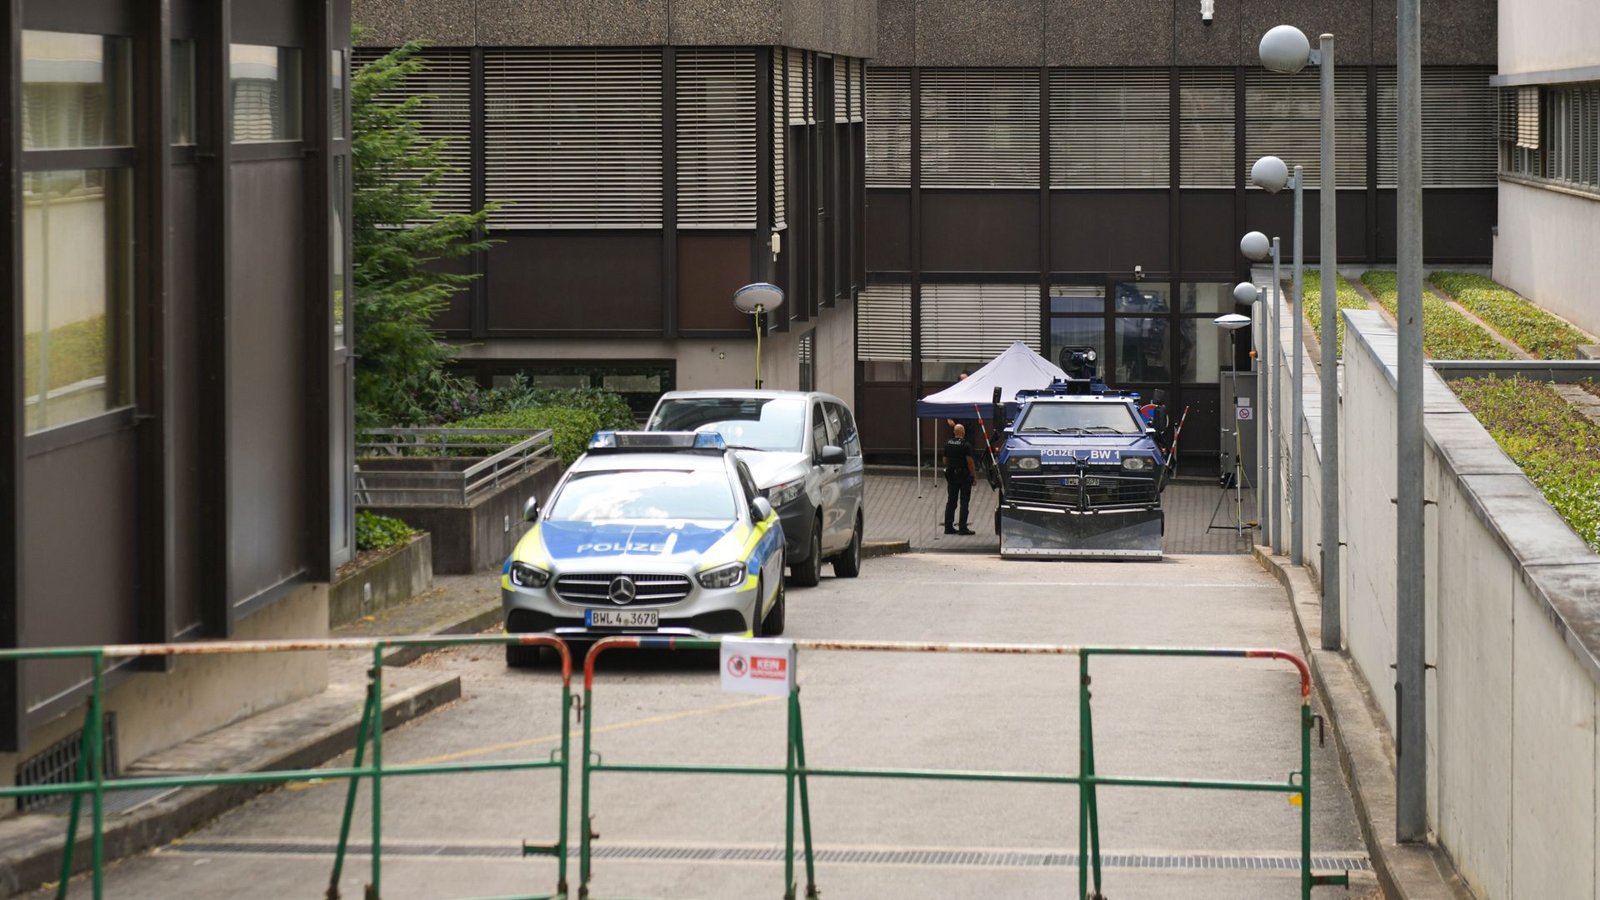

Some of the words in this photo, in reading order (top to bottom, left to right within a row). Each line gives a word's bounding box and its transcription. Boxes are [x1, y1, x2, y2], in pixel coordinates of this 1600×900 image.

[1090, 450, 1111, 459] BW
[1114, 450, 1120, 459] 1
[576, 542, 670, 553] POLIZE
[593, 612, 613, 625] BWL
[615, 612, 622, 625] 4
[630, 612, 657, 625] 3678
[757, 660, 780, 671] KEIN
